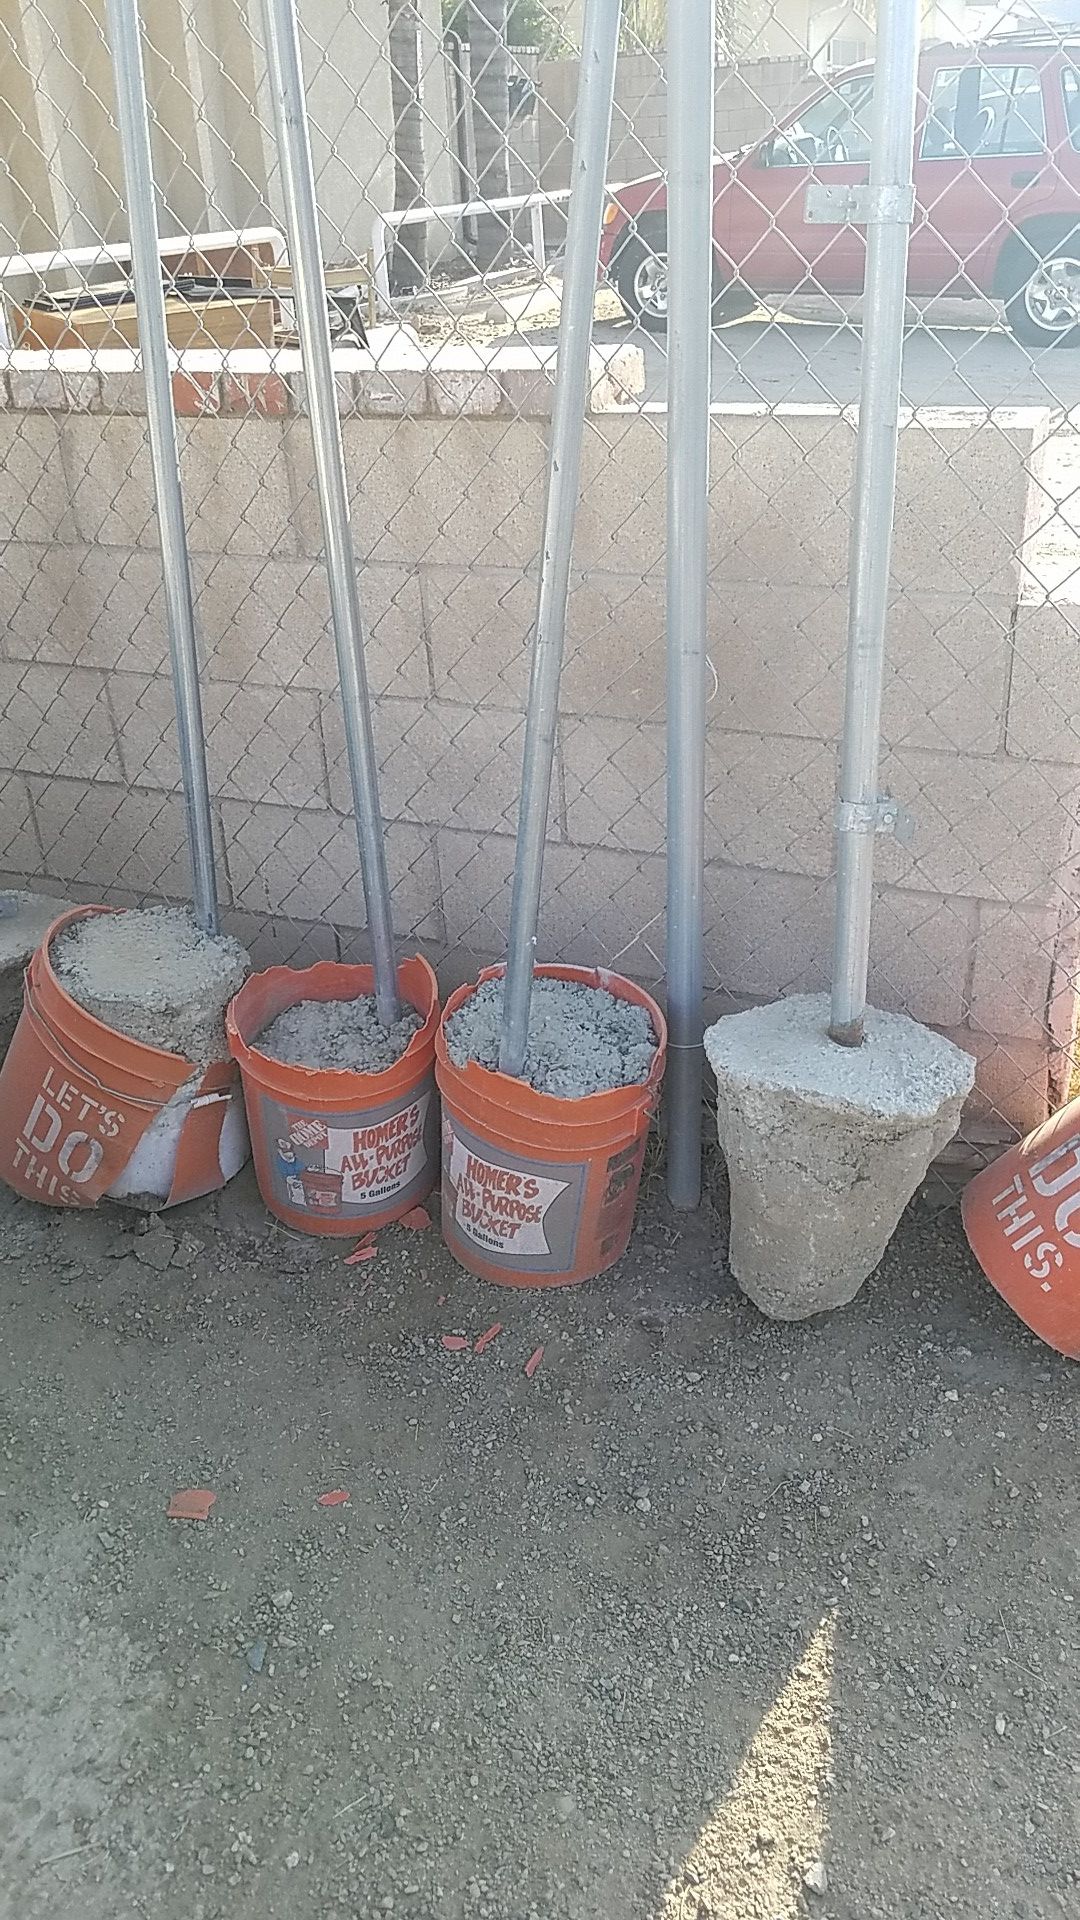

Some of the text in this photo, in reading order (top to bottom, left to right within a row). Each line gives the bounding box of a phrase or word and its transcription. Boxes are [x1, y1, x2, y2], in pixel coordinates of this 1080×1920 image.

[41, 1066, 125, 1137] LET'S
[22, 1094, 104, 1183] DO
[289, 1119, 328, 1146] HOME
[353, 1104, 420, 1153] HOMER'S
[351, 1153, 411, 1191] BUCKET
[360, 1181, 401, 1200] 5 Gallons
[465, 1154, 539, 1199] HOMER'S
[462, 1198, 521, 1239] BUCKET
[465, 1223, 504, 1249] 5 Gallons
[992, 1173, 1063, 1292] THIS.
